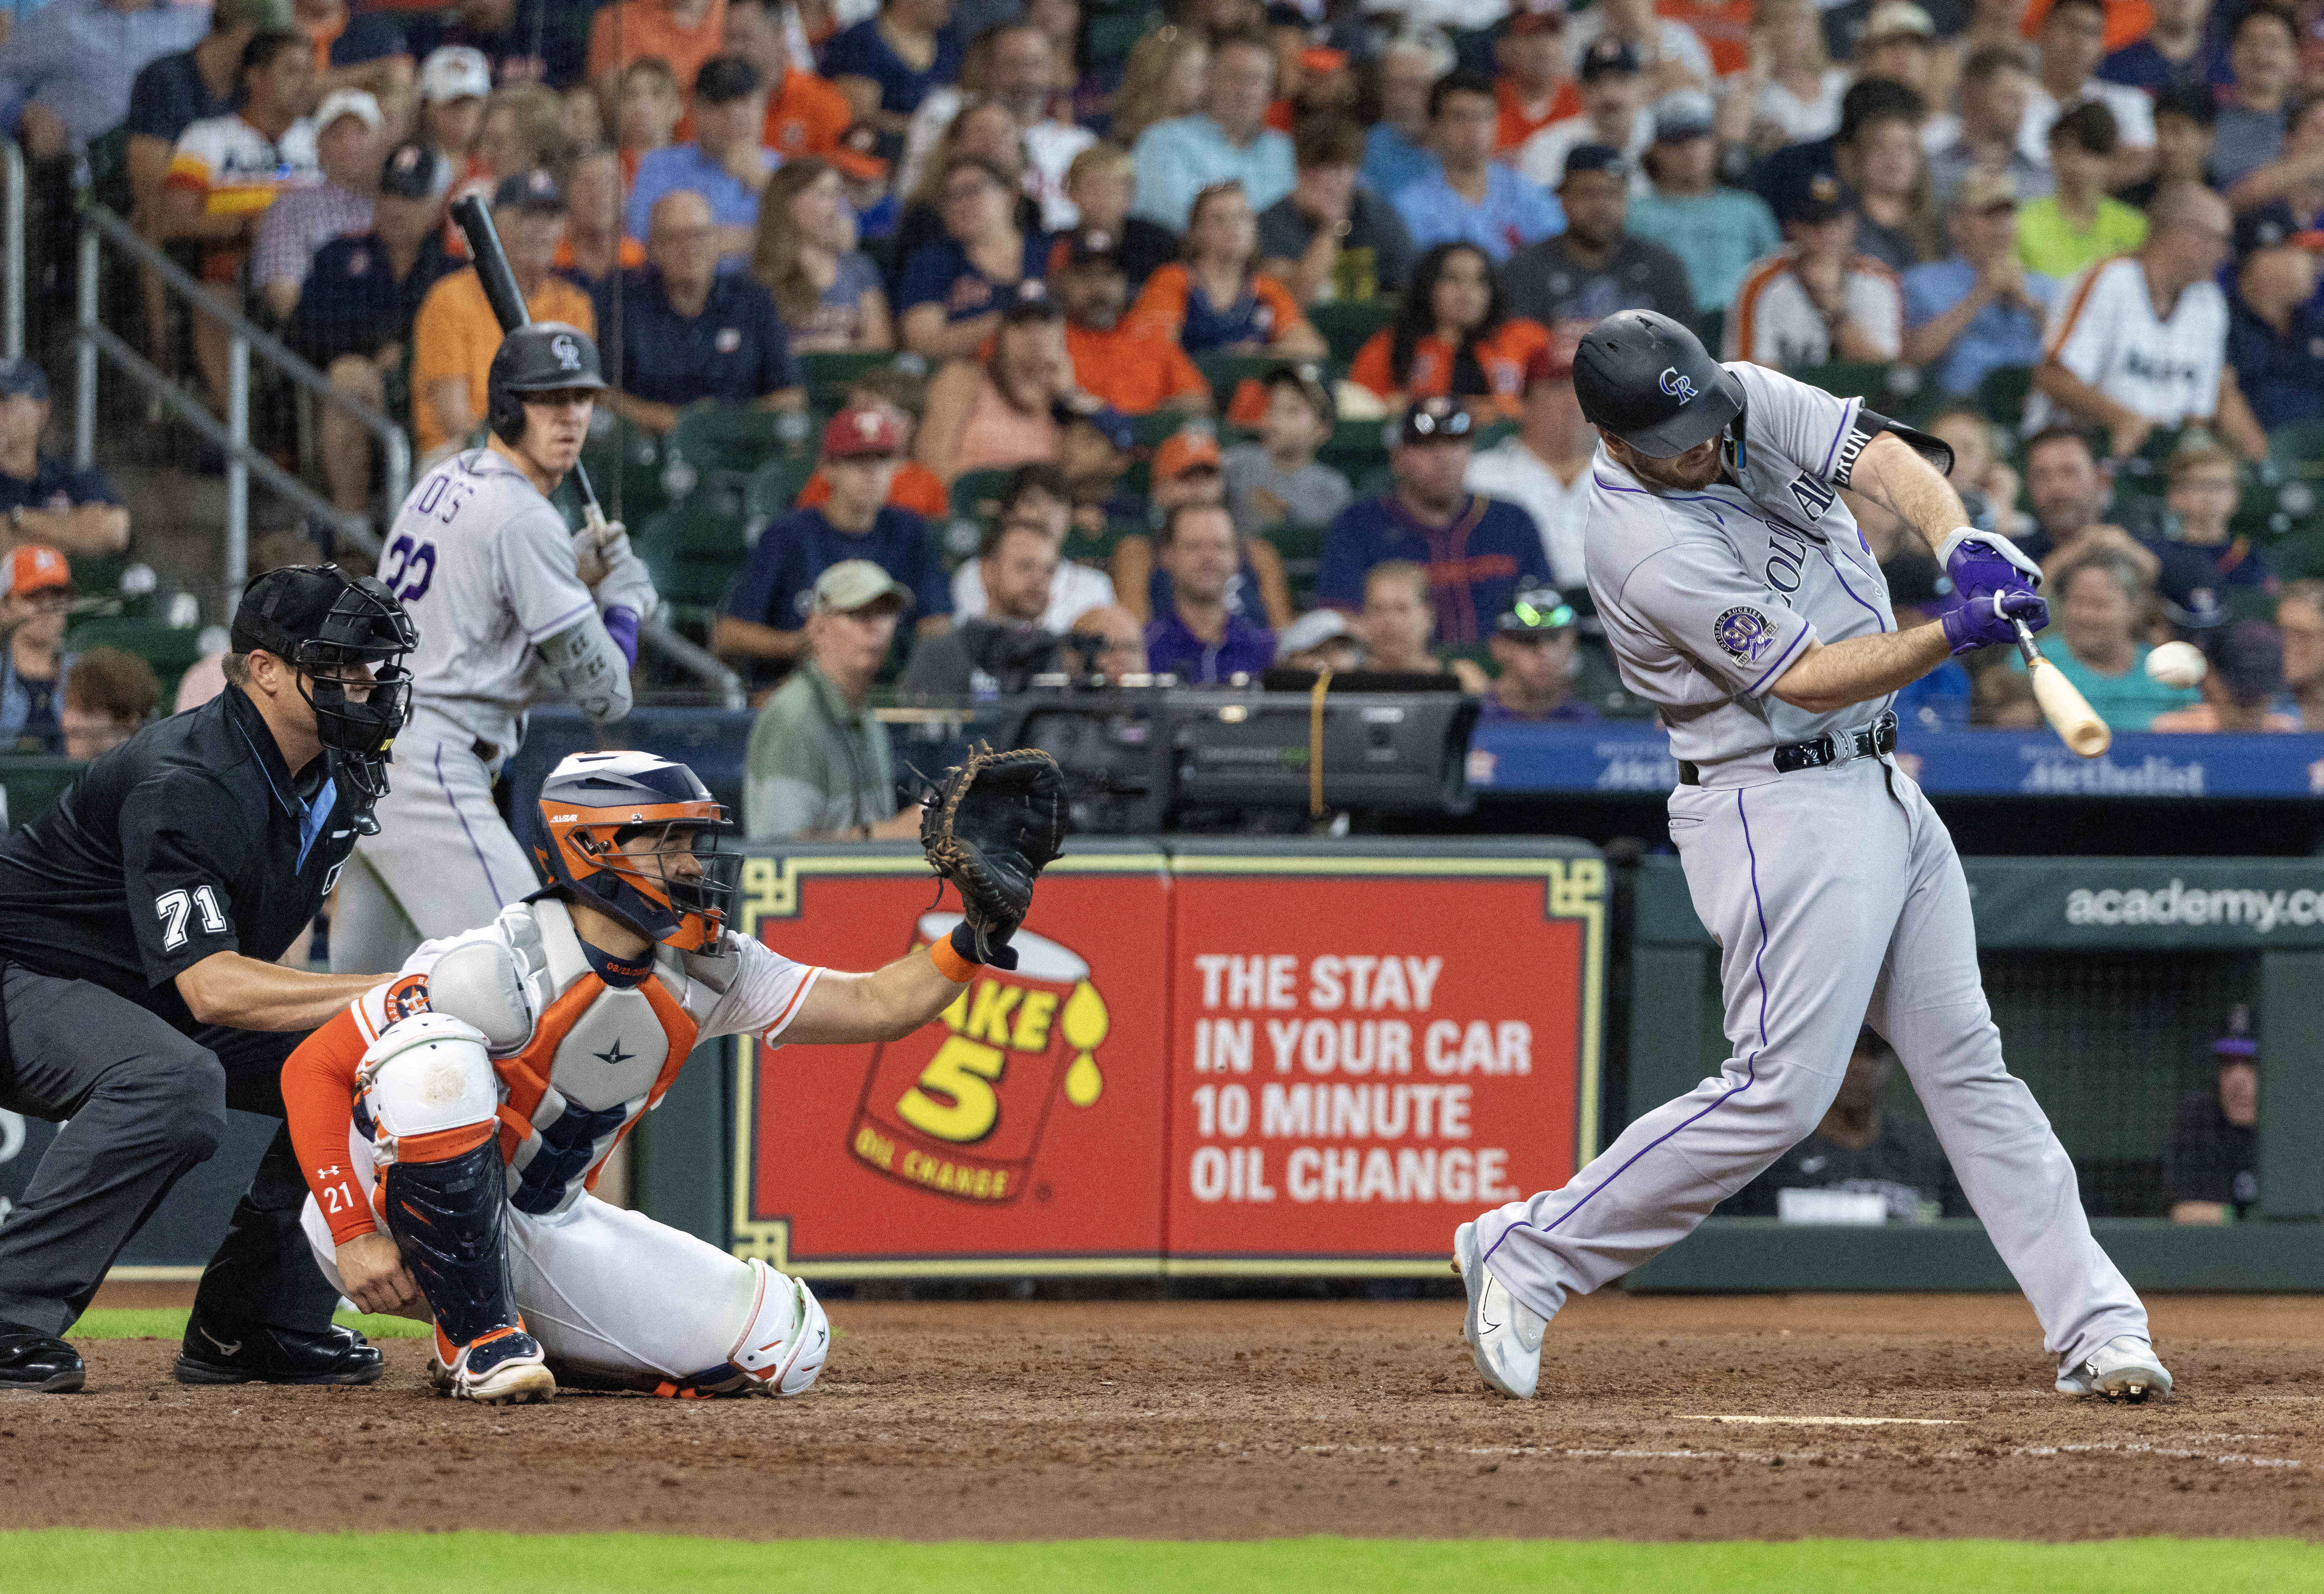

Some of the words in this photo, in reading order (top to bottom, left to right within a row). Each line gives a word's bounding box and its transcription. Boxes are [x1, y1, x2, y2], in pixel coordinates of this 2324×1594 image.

[1724, 616, 1759, 648] 30
[1727, 606, 1762, 619] ROCKIES
[155, 884, 228, 952] 71
[2066, 879, 2324, 933] academy.c
[1195, 954, 1299, 1009] THE
[1309, 954, 1443, 1011] STAY
[939, 979, 1058, 1053] AKE
[1195, 1018, 1254, 1074] IN
[1267, 1018, 1412, 1075] YOUR
[1424, 1020, 1532, 1075] CAR
[895, 1033, 1006, 1142] 5
[1191, 1084, 1251, 1137] 10
[1261, 1084, 1473, 1139] MINUTE
[855, 1127, 896, 1171] OIL
[902, 1149, 1010, 1200] CHANGE
[1189, 1147, 1276, 1202] OIL
[323, 1181, 354, 1214] 21
